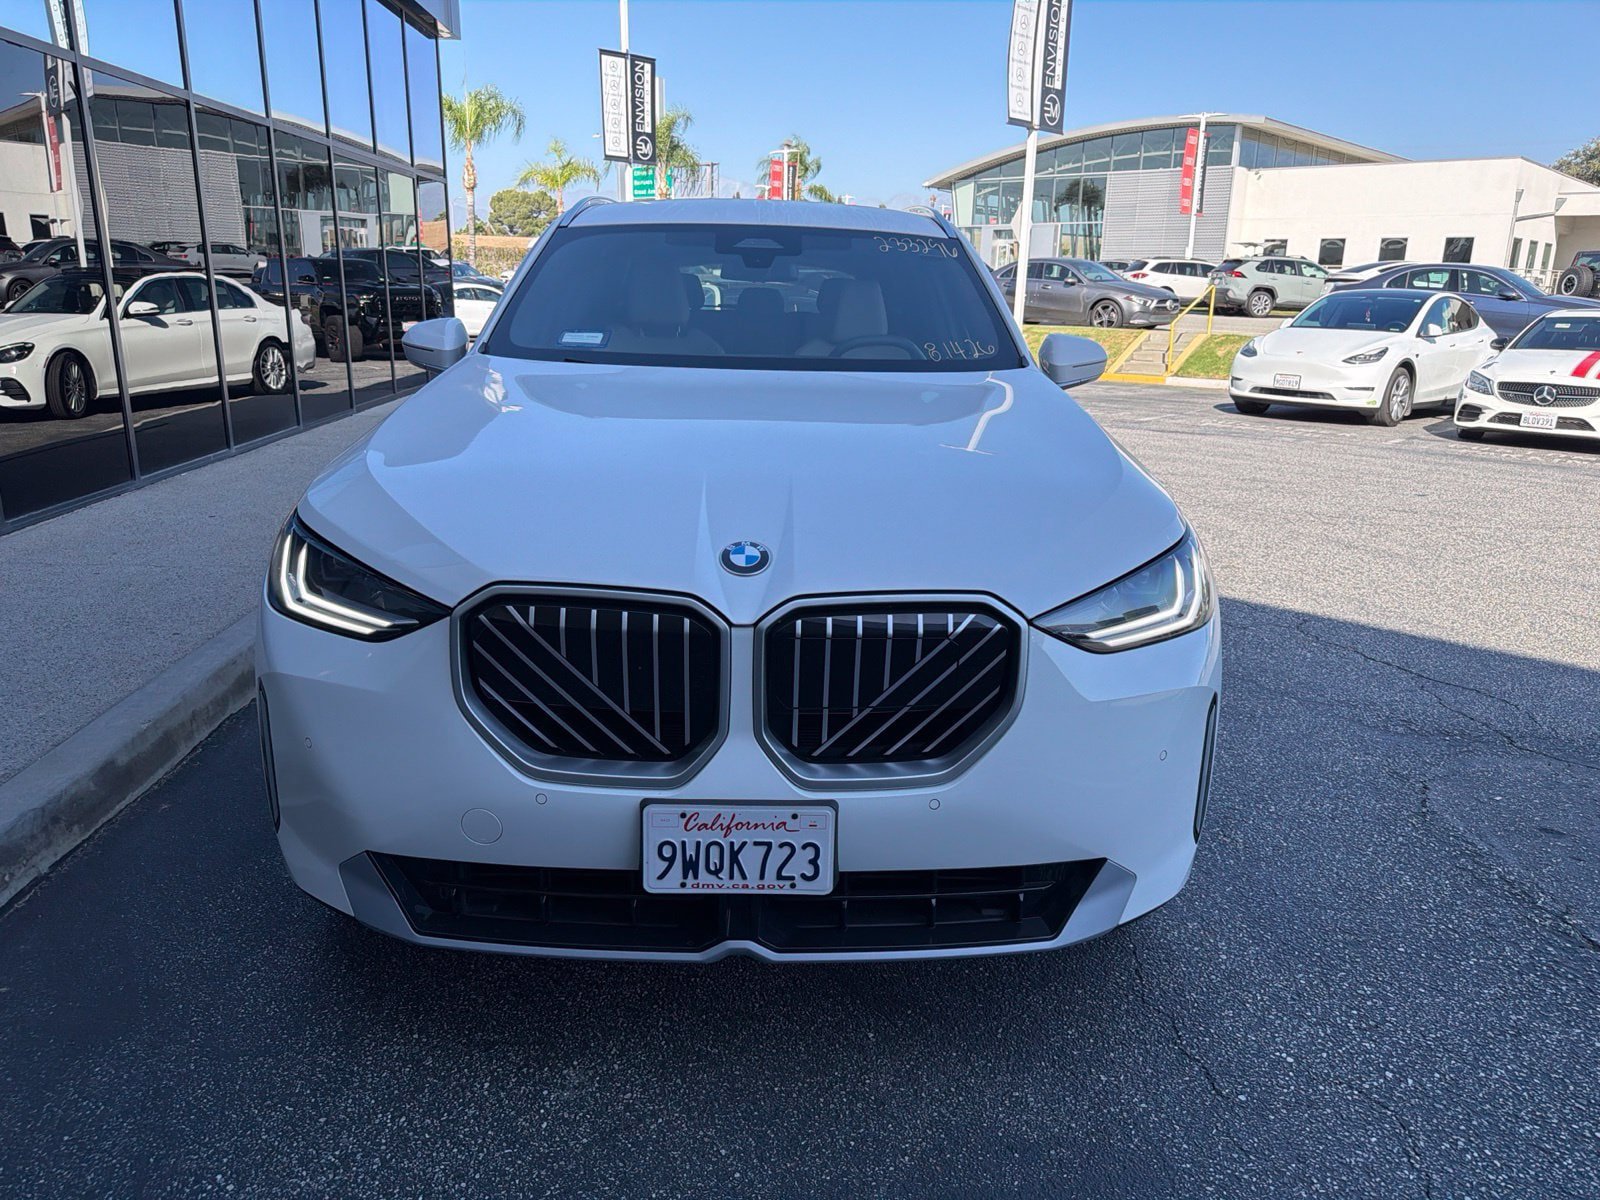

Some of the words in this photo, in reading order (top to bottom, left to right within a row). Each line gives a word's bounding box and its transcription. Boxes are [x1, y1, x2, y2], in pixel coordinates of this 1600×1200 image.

[1056, 4, 1066, 81] MOTORS
[634, 60, 646, 133] ENVISION
[683, 812, 800, 838] California
[656, 840, 822, 882] 9WQK723
